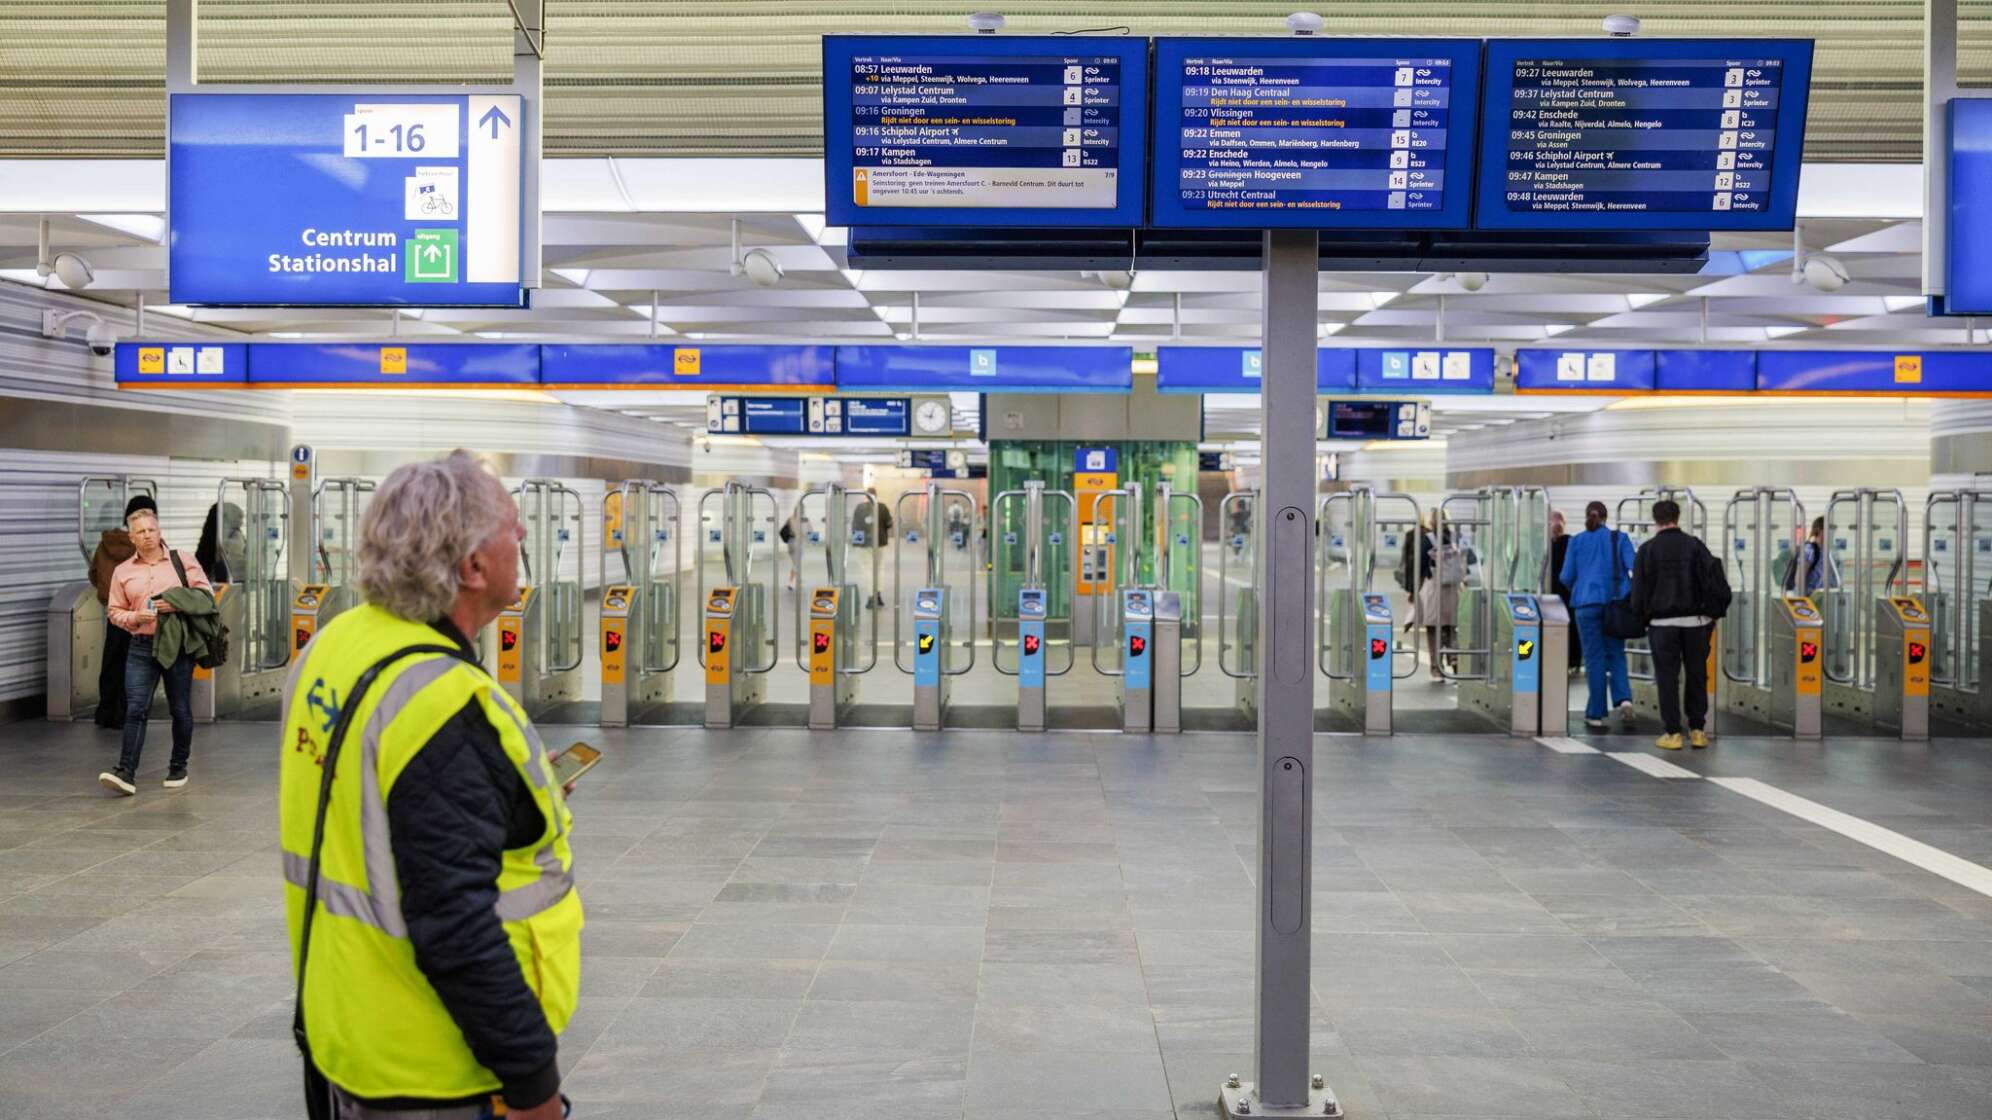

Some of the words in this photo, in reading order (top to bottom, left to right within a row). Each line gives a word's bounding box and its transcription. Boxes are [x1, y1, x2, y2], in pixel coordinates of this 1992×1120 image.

[855, 65, 878, 73] 08:57
[881, 65, 932, 73] Leeuwarden
[1186, 67, 1209, 75] 09:18
[1212, 67, 1263, 75] Leeuwarden
[1516, 69, 1539, 77] 09:27
[1542, 69, 1593, 77] Leeuwarden
[957, 76, 987, 84] Wolvega,
[855, 86, 878, 94] 09:07
[881, 86, 915, 96] Lelystad
[918, 86, 953, 94] Centrum
[1186, 88, 1208, 96] 09:19
[1212, 88, 1227, 96] Den
[1230, 88, 1251, 97] Haag
[1255, 88, 1289, 96] Centraal
[1515, 90, 1538, 98] 09:37
[1541, 90, 1575, 99] Lelystad
[1578, 90, 1613, 98] Centrum
[1302, 99, 1345, 107] wisselstoring
[856, 107, 878, 115] 09:16
[881, 107, 925, 116] Groningen
[1185, 109, 1208, 117] 09:20
[1211, 109, 1253, 118] Vlissingen
[1513, 111, 1536, 119] 09:42
[1301, 120, 1344, 128] wisselstoring
[881, 128, 917, 137] Schiphol
[920, 128, 949, 137] Airport
[1184, 129, 1207, 137] 09:22
[1210, 129, 1240, 137] Emmen
[1512, 131, 1535, 139] 09:45
[1538, 131, 1581, 141] Groningen
[856, 148, 878, 156] 09:17
[882, 148, 915, 157] Kampen
[1184, 150, 1206, 158] 09:22
[1209, 150, 1248, 158] Enschede
[1536, 152, 1571, 161] Schiphol
[1574, 152, 1604, 161] Airport
[893, 158, 931, 166] Stadshagen
[1547, 162, 1574, 170] Lelystad
[1183, 170, 1205, 178] 09:23
[1209, 170, 1252, 180] Groningen
[1255, 171, 1301, 180] Hoogeveen
[1509, 172, 1532, 180] 09:47
[1535, 172, 1568, 181] Kampen
[1720, 178, 1728, 186] 12
[1182, 191, 1205, 199] 09:23
[1208, 191, 1238, 199] Utrecht
[1241, 191, 1275, 199] Centraal
[1507, 192, 1530, 200] 09:48
[1298, 201, 1340, 209] wisselstoring
[302, 229, 396, 246] Centrum
[269, 254, 396, 272] Stationshal
